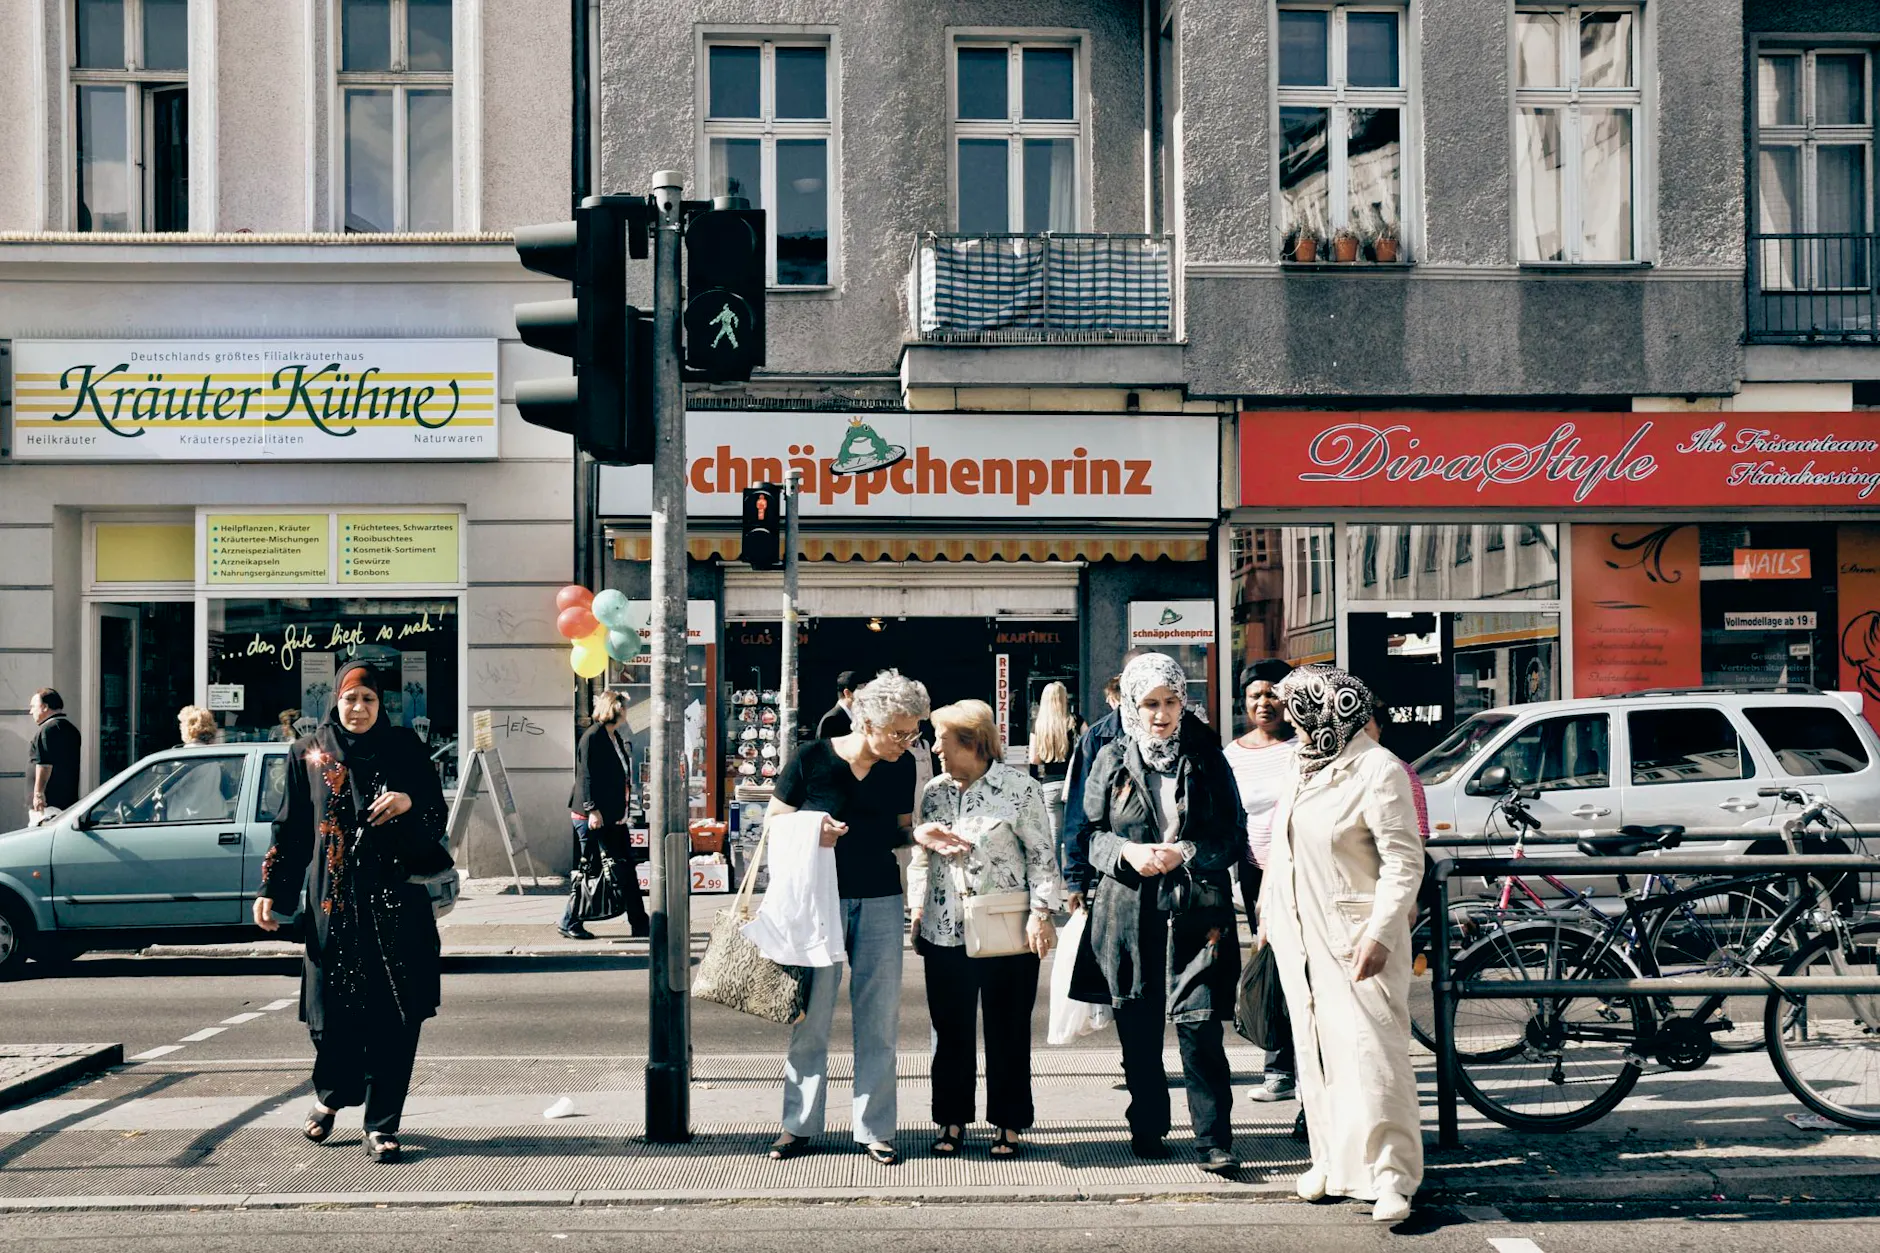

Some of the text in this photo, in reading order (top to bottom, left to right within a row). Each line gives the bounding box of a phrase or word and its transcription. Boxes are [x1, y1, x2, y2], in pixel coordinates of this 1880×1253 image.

[131, 351, 364, 364] Deutschlands größtes Filialkräuterhaus
[52, 362, 459, 437] Kräuter Kühne
[27, 434, 97, 445] Heilkräuter
[180, 433, 304, 445] Kräuterspezialitäten
[414, 433, 483, 444] Naturwaren
[1731, 428, 1879, 453] Friseurteam
[1726, 460, 1880, 499] Hairdressing
[353, 524, 401, 532] Früchtetees,
[220, 536, 319, 544] Kräutertee-Mischungen
[220, 547, 301, 555] Arzneispezialitäten
[220, 558, 280, 566] Arzneikapseln
[1742, 552, 1804, 575] NAILS
[220, 569, 326, 577] Nahrungsergänzungsmittel
[1726, 616, 1783, 628] Vollmodellage
[1784, 615, 1794, 626] ab
[1797, 615, 1808, 626] 19
[1132, 628, 1213, 639] schnäppchenprinz
